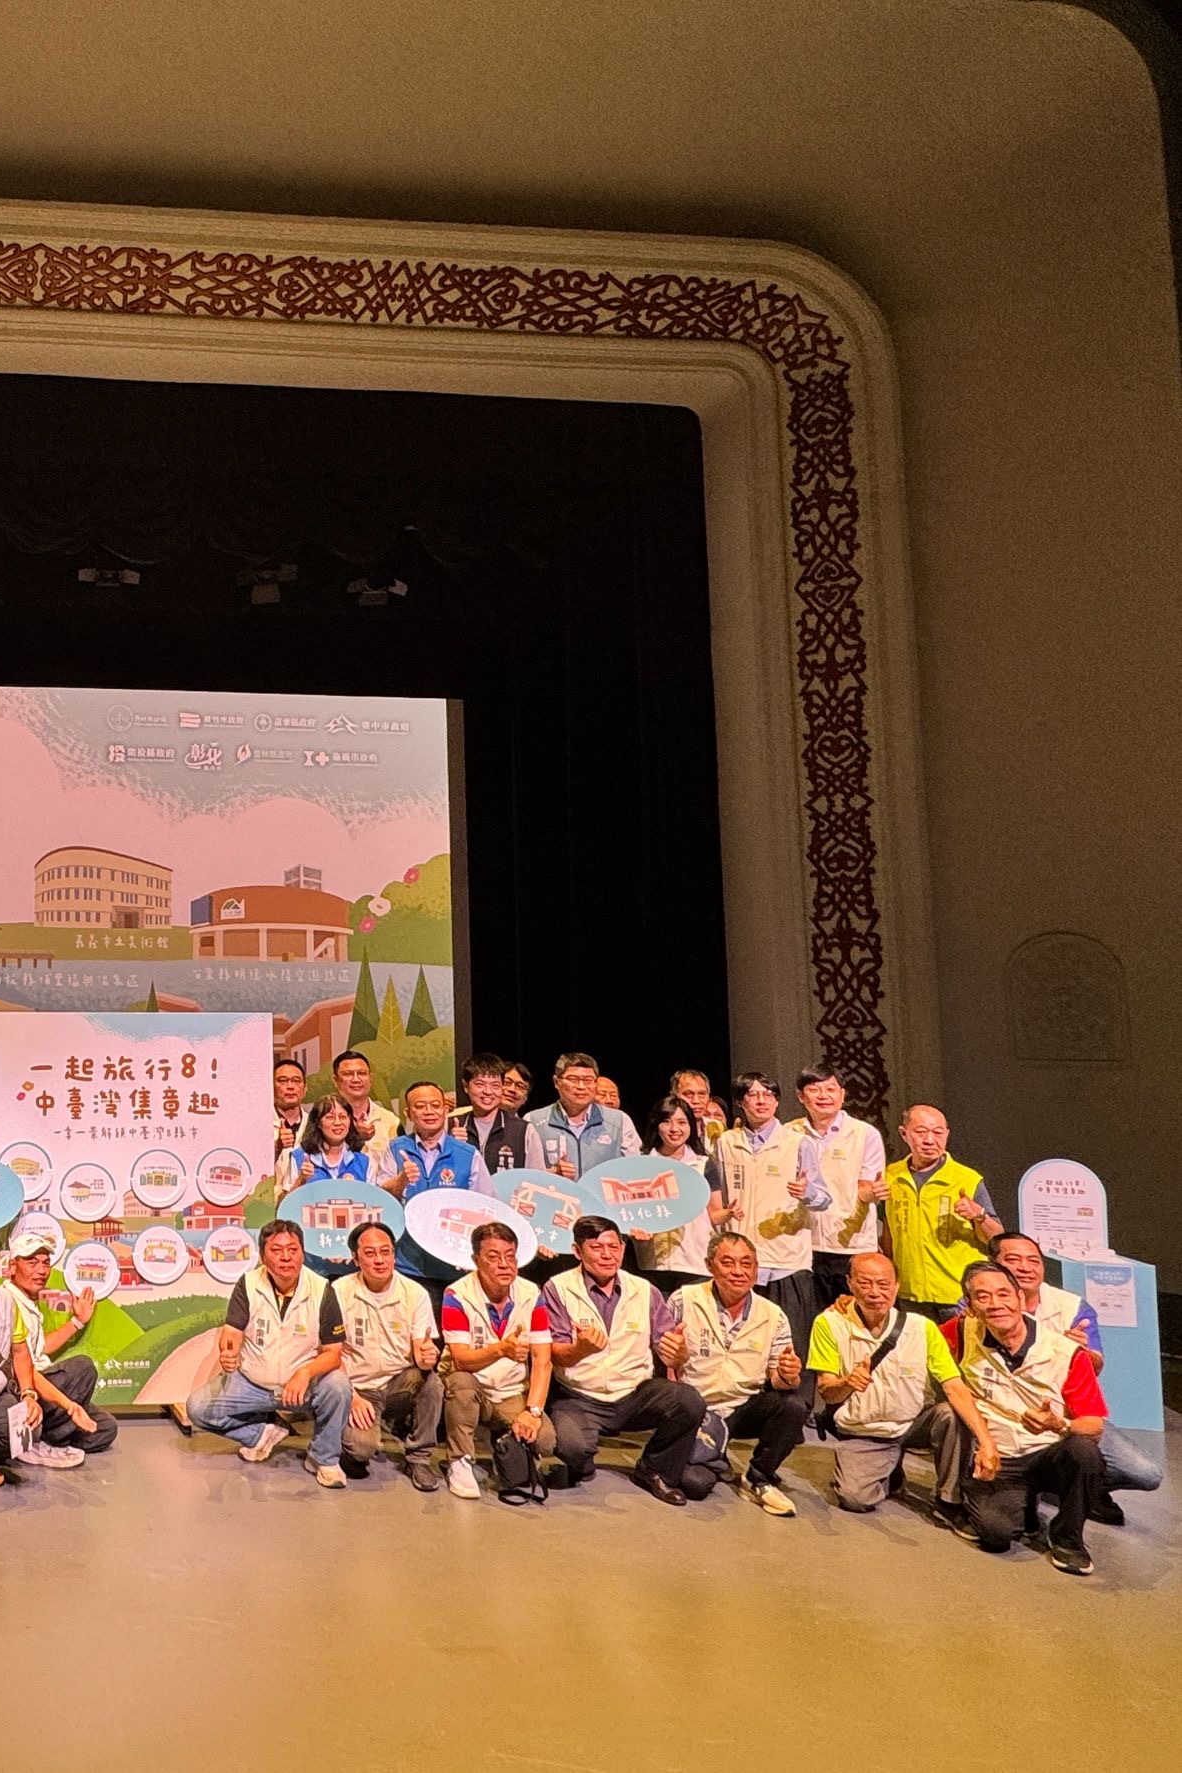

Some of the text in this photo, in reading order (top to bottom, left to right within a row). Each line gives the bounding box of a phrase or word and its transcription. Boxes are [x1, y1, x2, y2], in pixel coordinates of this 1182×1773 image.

[35, 1086, 220, 1120] 中臺灣集章趣
[619, 1205, 673, 1221] 彰化縣
[319, 1232, 348, 1249] 新竹
[534, 1227, 559, 1243] 中市
